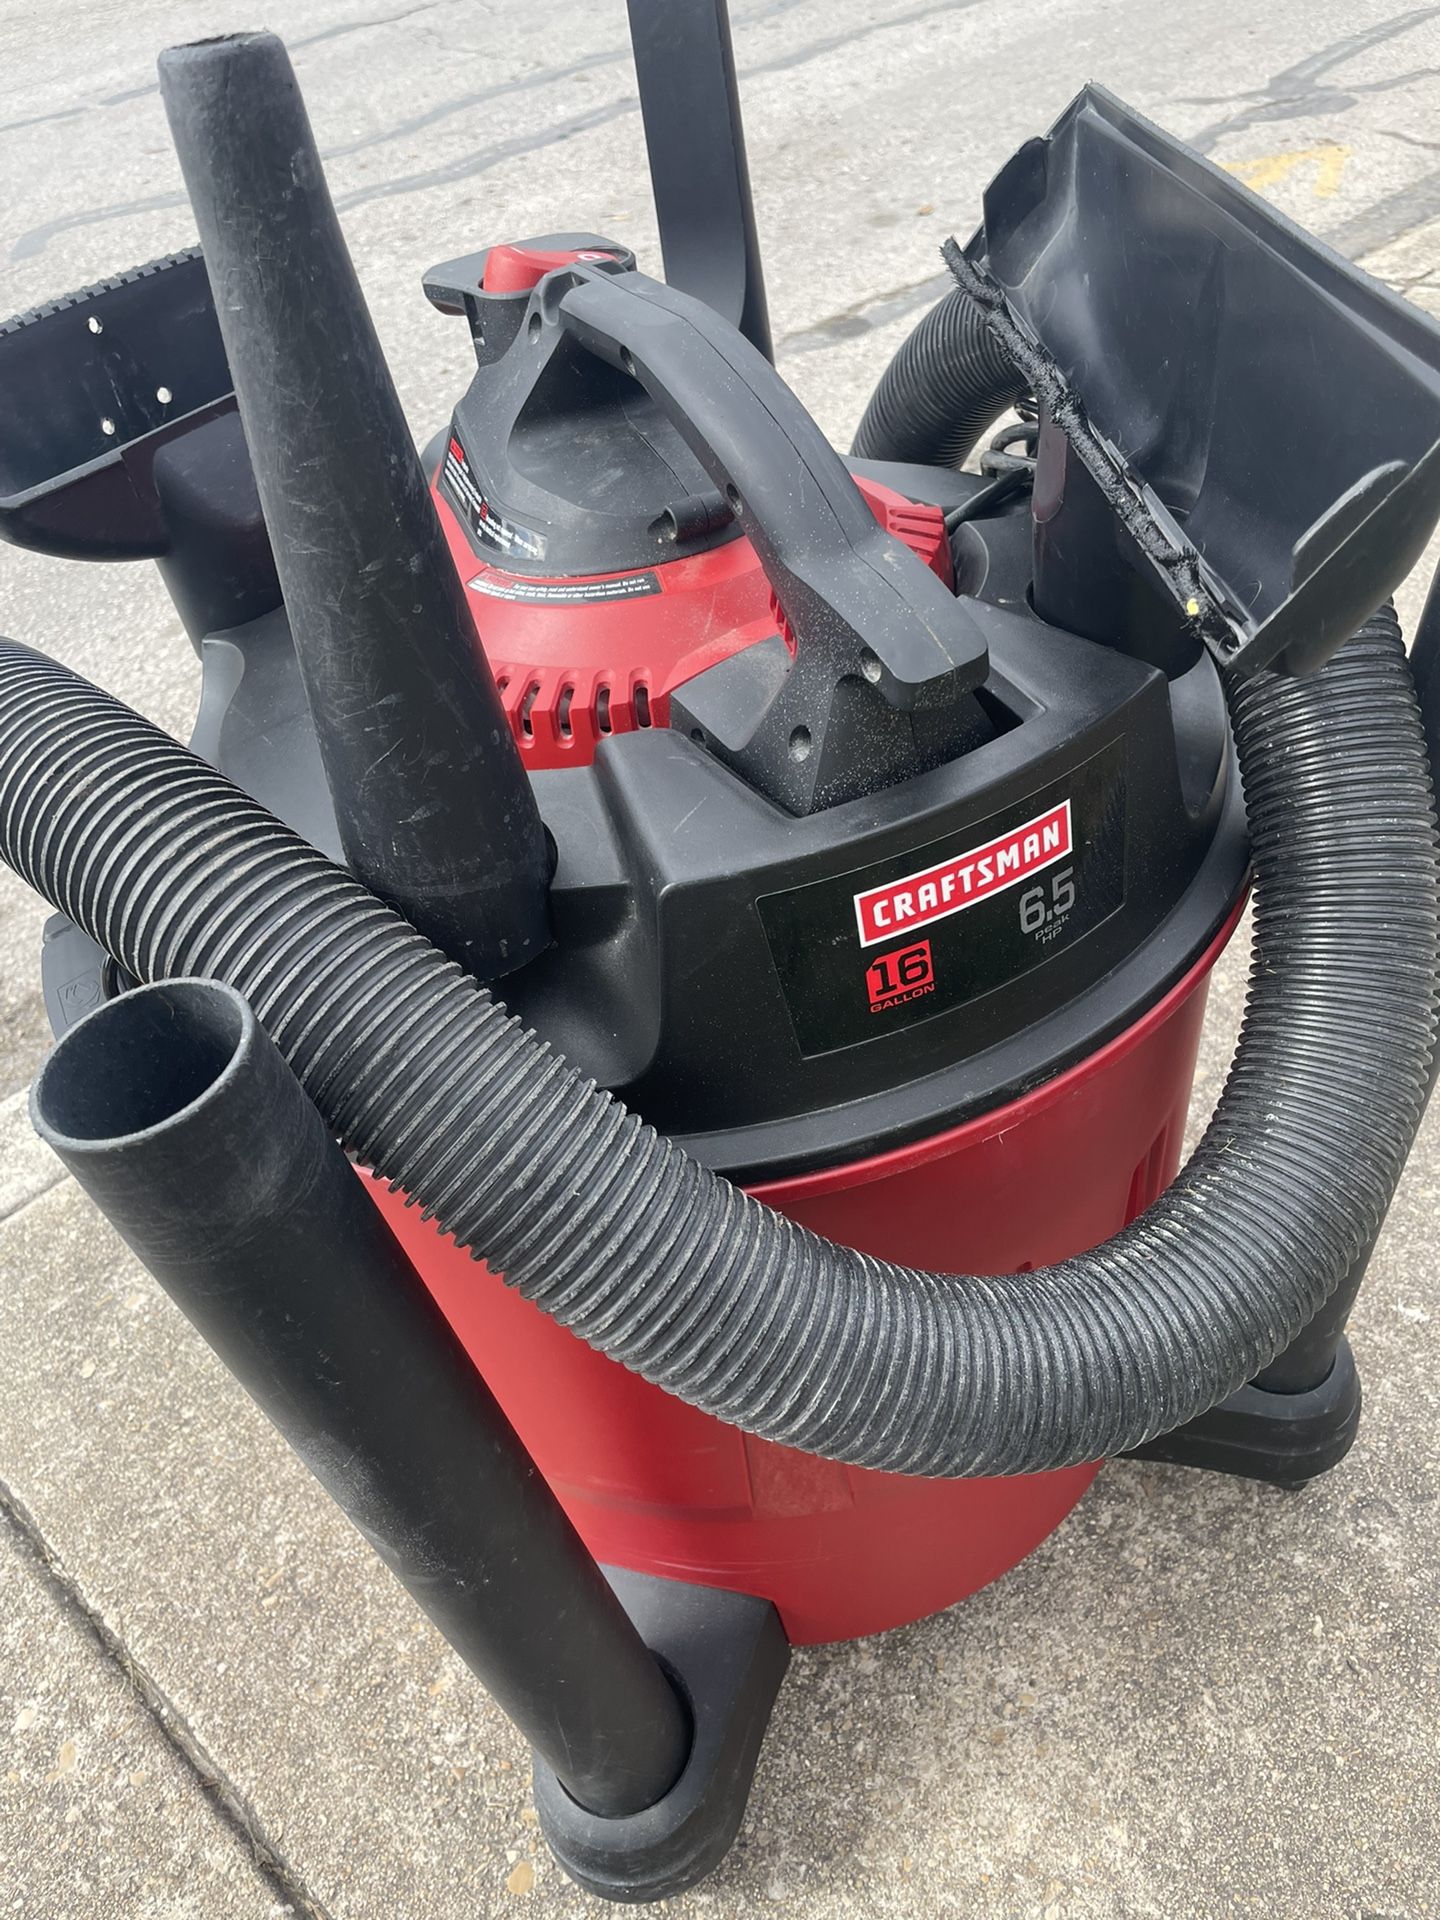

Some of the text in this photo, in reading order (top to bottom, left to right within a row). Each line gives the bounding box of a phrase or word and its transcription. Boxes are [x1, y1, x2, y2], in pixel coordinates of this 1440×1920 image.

[873, 820, 1060, 928] CRAFTSMAN
[1019, 866, 1075, 935] 6.5
[1042, 926, 1063, 944] HP
[872, 947, 929, 997] 16
[870, 983, 935, 1013] GALLON
